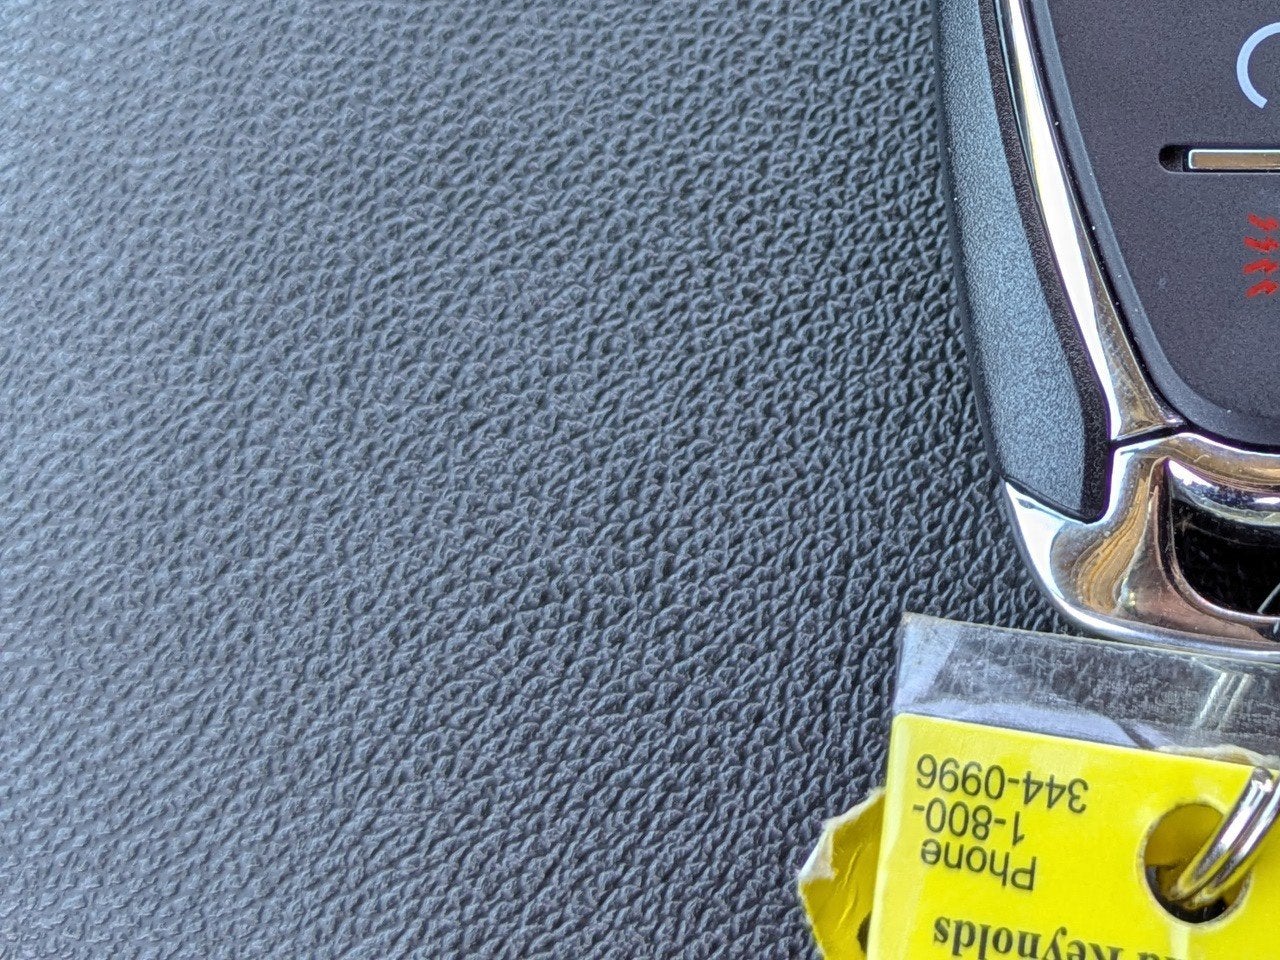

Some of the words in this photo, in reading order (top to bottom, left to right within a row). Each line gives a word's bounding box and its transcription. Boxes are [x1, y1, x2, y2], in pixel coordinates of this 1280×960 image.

[916, 753, 1089, 814] 344-0996
[912, 797, 1025, 846] 1-800-
[920, 838, 1037, 891] Phone
